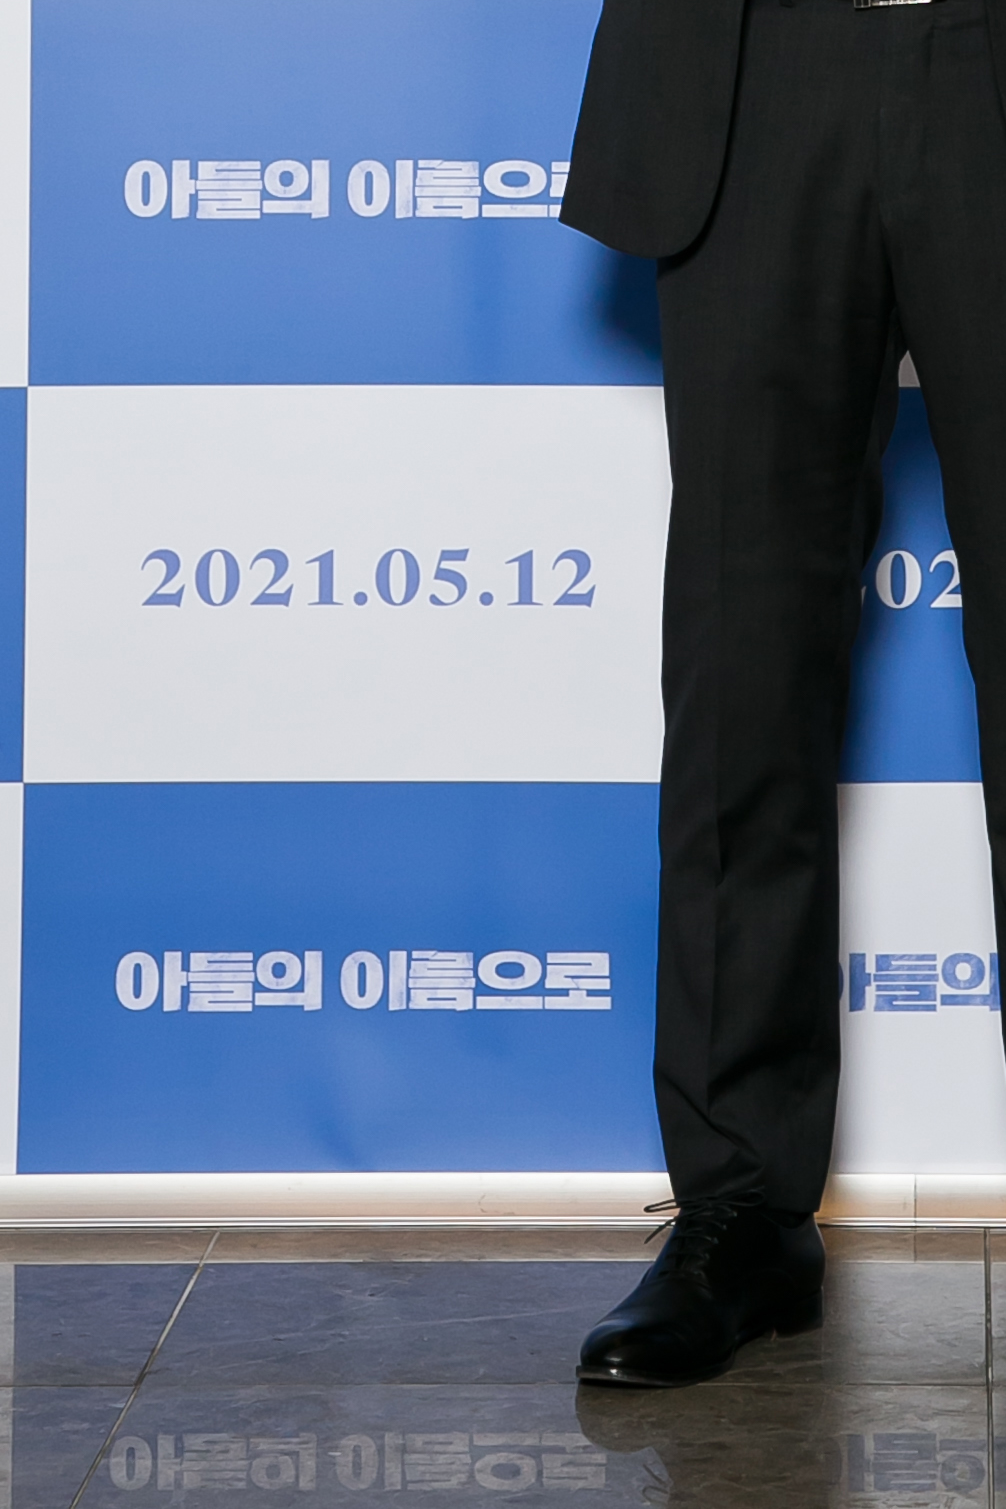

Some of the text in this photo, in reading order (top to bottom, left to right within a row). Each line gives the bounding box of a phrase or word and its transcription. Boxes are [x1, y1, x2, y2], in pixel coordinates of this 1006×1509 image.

[124, 159, 570, 220] 아들의 이름으
[141, 548, 597, 608] 2021.05.12
[115, 950, 613, 1013] 아들의 이름으로
